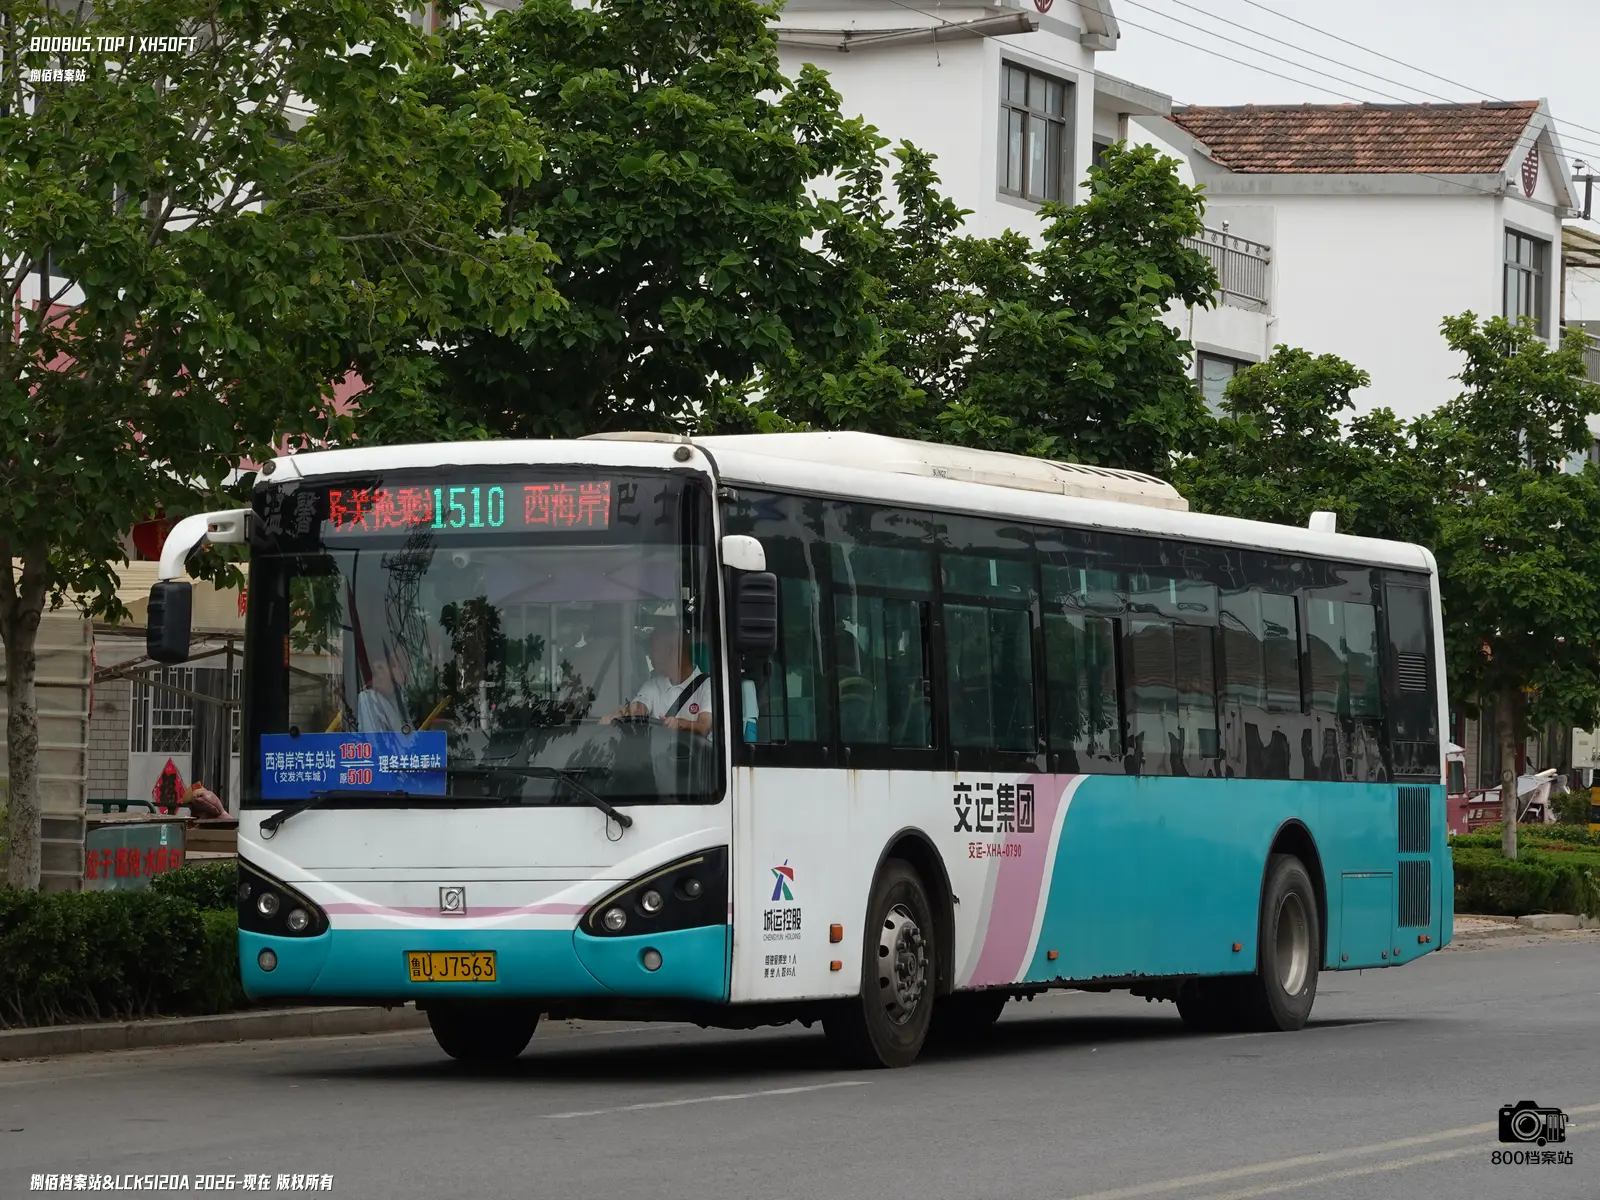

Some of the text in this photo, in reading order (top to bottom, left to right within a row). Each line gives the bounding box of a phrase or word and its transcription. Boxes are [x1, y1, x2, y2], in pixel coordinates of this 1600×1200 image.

[431, 486, 504, 529] 1510
[264, 750, 336, 771] 西海岸汽车总站
[339, 743, 373, 759] 1510
[953, 782, 1035, 833] 交运集团
[968, 841, 1022, 859] 交运-XHA-0790
[763, 908, 801, 932] 城运控股
